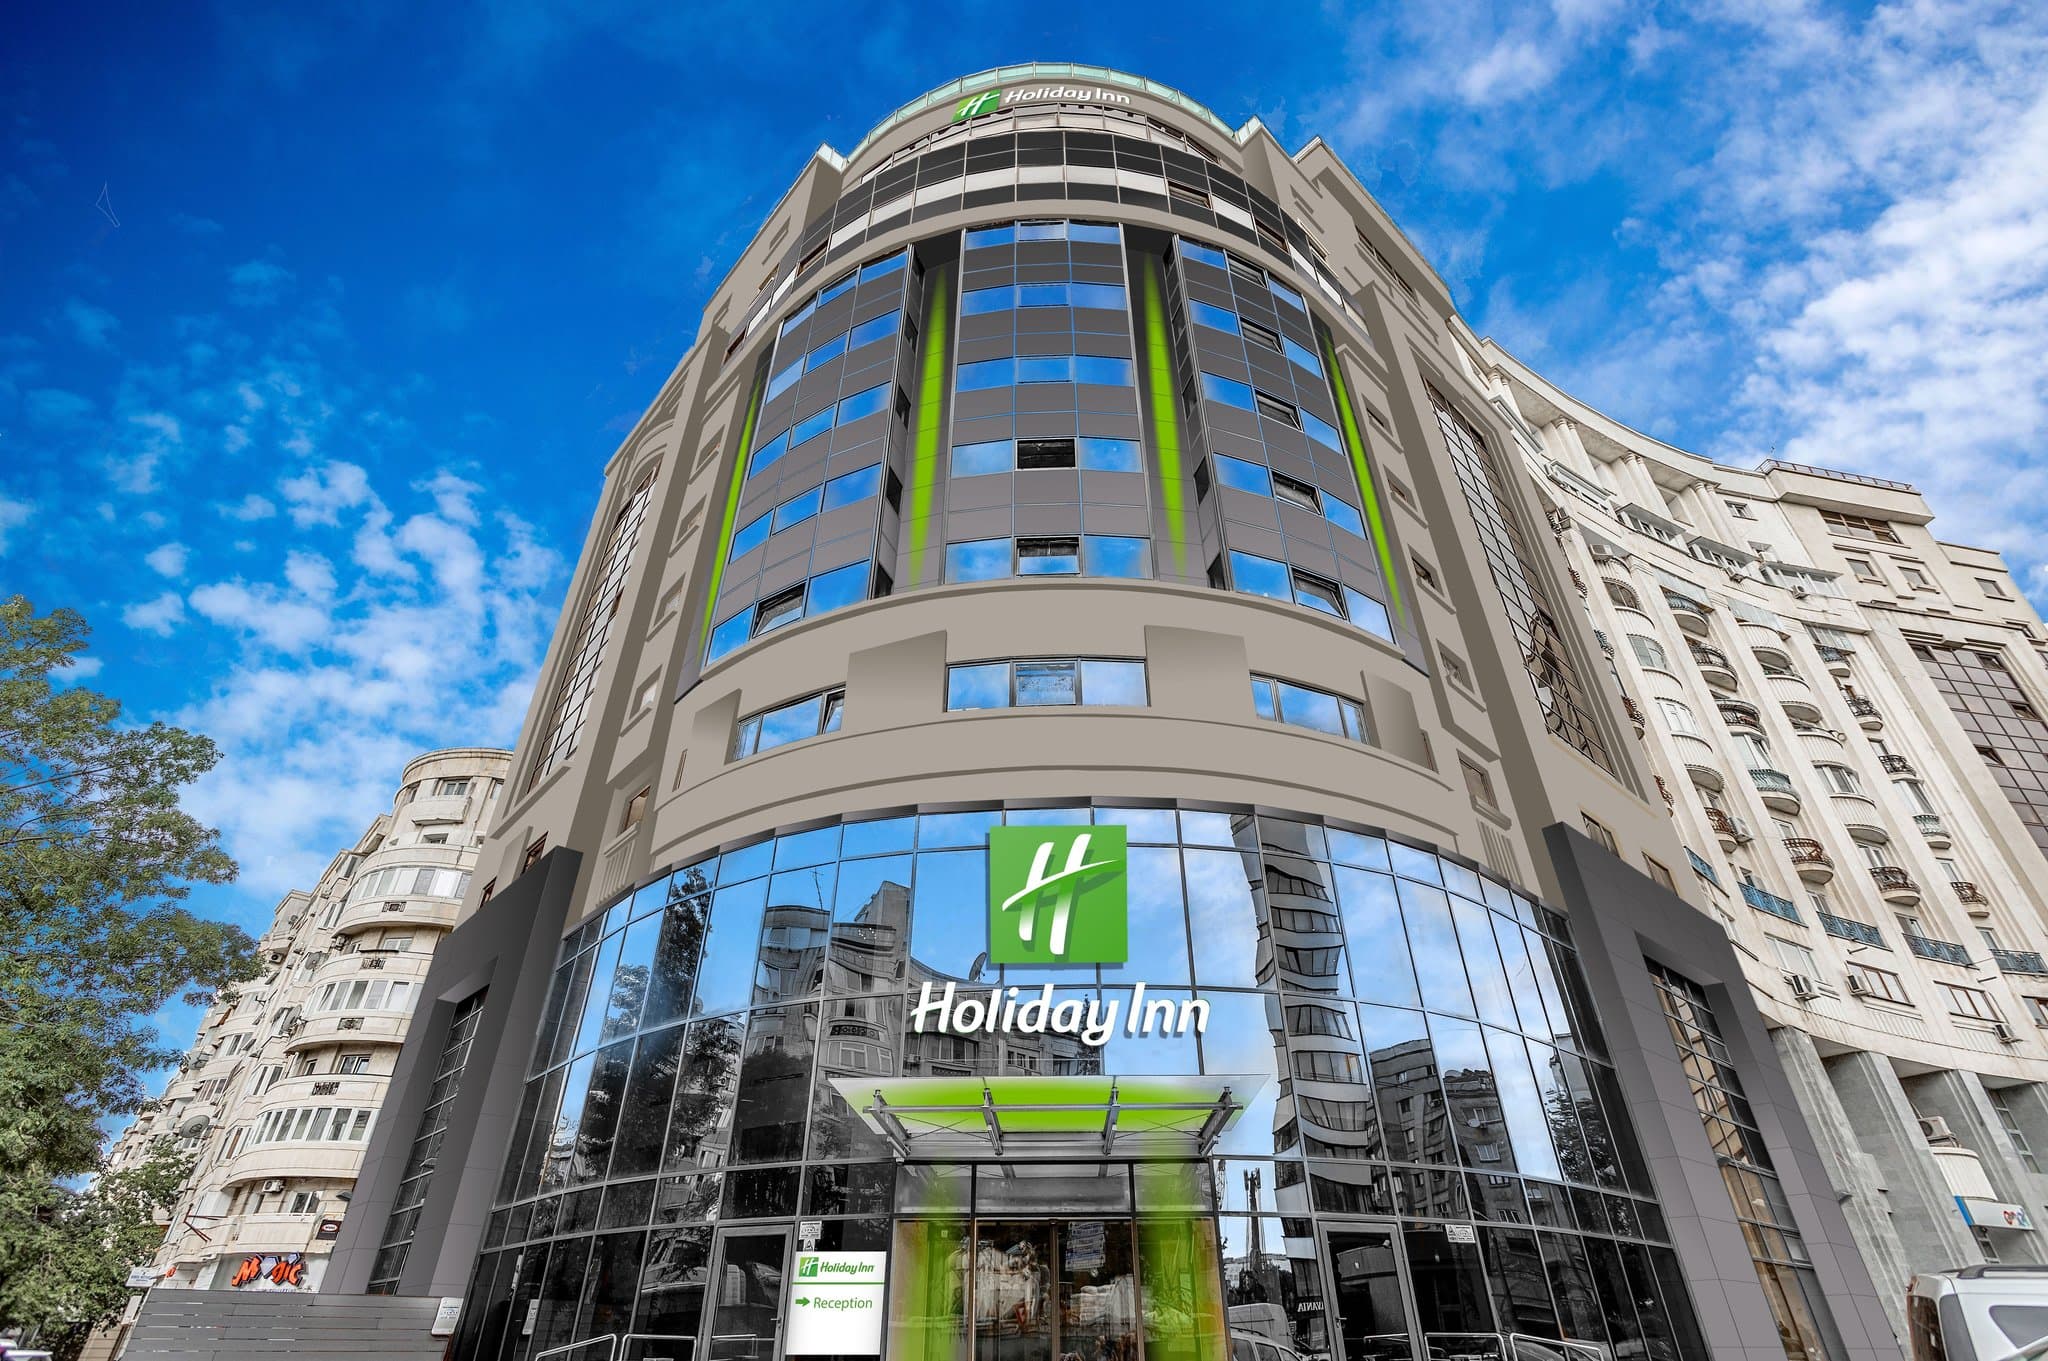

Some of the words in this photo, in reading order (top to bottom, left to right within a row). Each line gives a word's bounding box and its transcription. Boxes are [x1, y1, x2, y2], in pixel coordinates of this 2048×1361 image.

[1004, 86, 1093, 104] Holiday
[1096, 87, 1131, 104] Inn
[910, 981, 1120, 1046] Holiday
[1127, 981, 1210, 1034] Inn
[820, 1261, 858, 1275] Holiday
[858, 1262, 875, 1273] Inn
[813, 1296, 873, 1311] Reception
